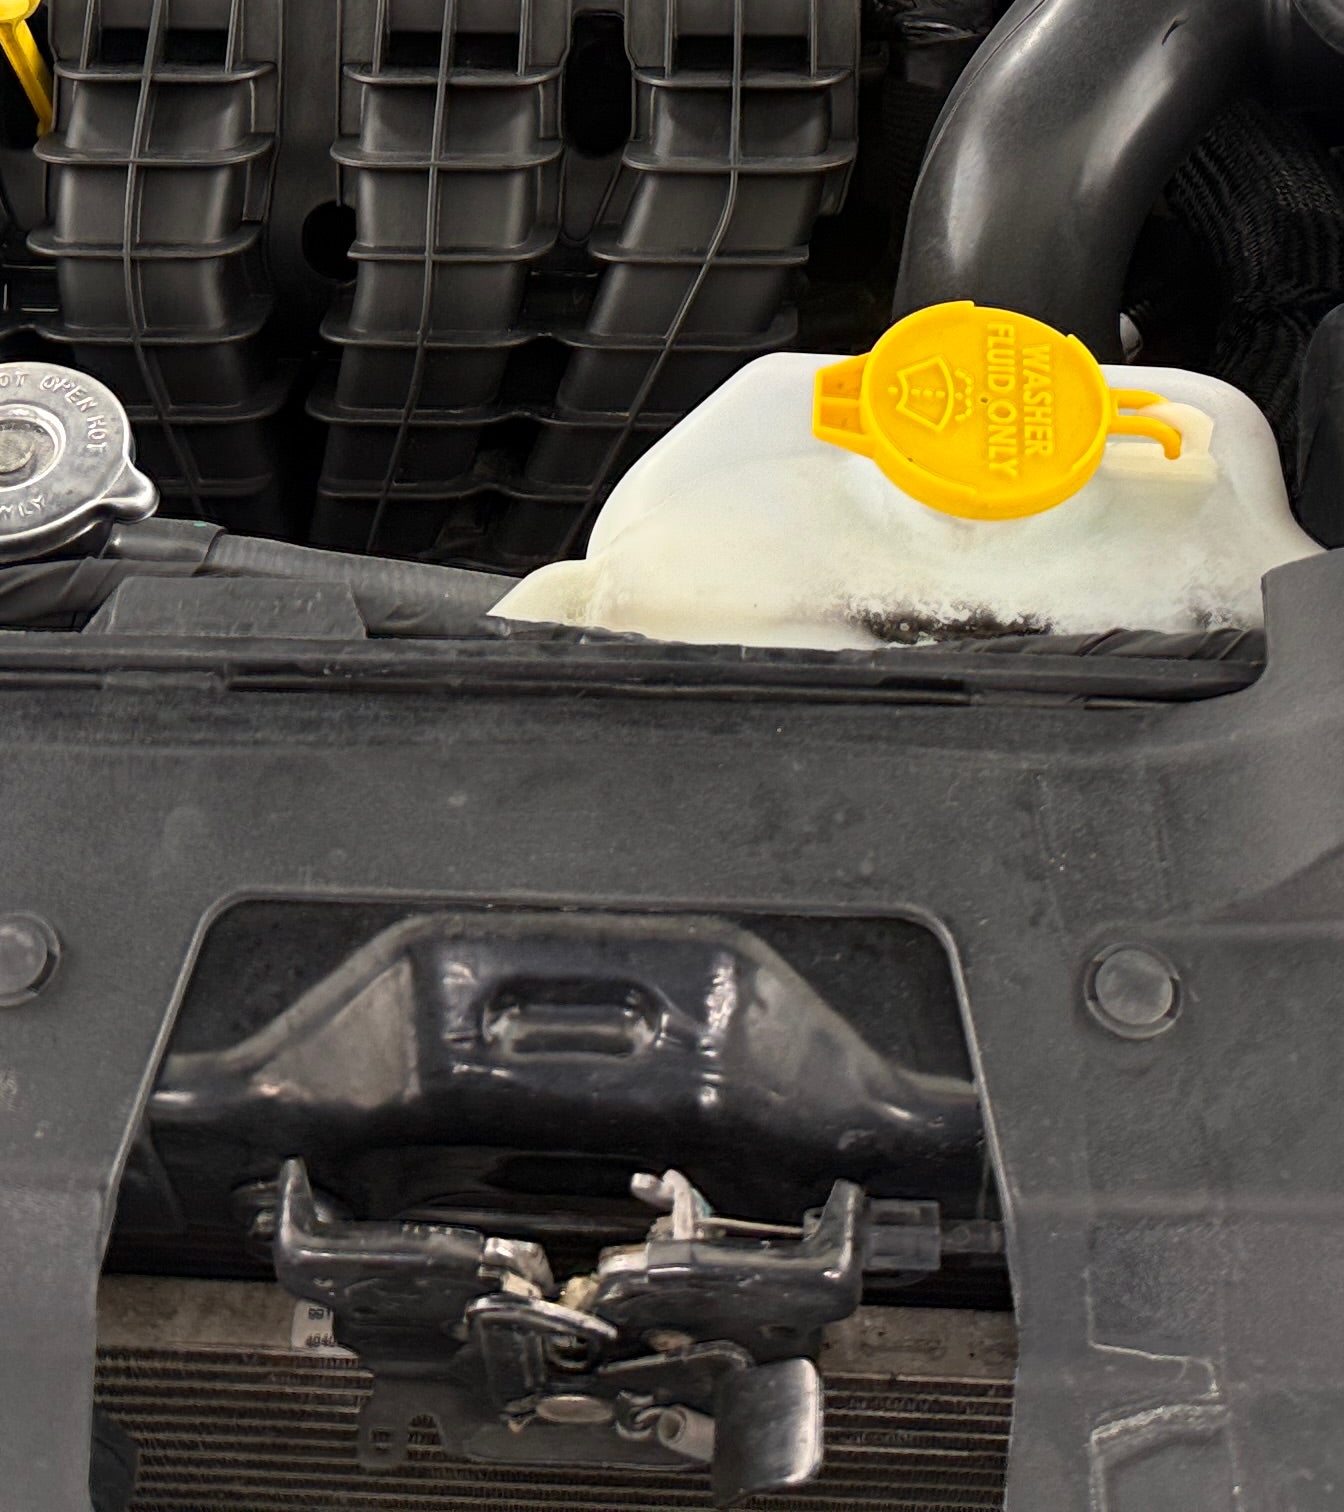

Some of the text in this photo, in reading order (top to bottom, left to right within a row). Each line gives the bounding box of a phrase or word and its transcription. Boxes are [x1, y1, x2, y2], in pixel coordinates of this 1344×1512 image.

[40, 374, 98, 413] OPEN
[86, 413, 108, 451] HOT
[986, 320, 1017, 479] FLUID ONLY
[1021, 341, 1054, 459] WASHER
